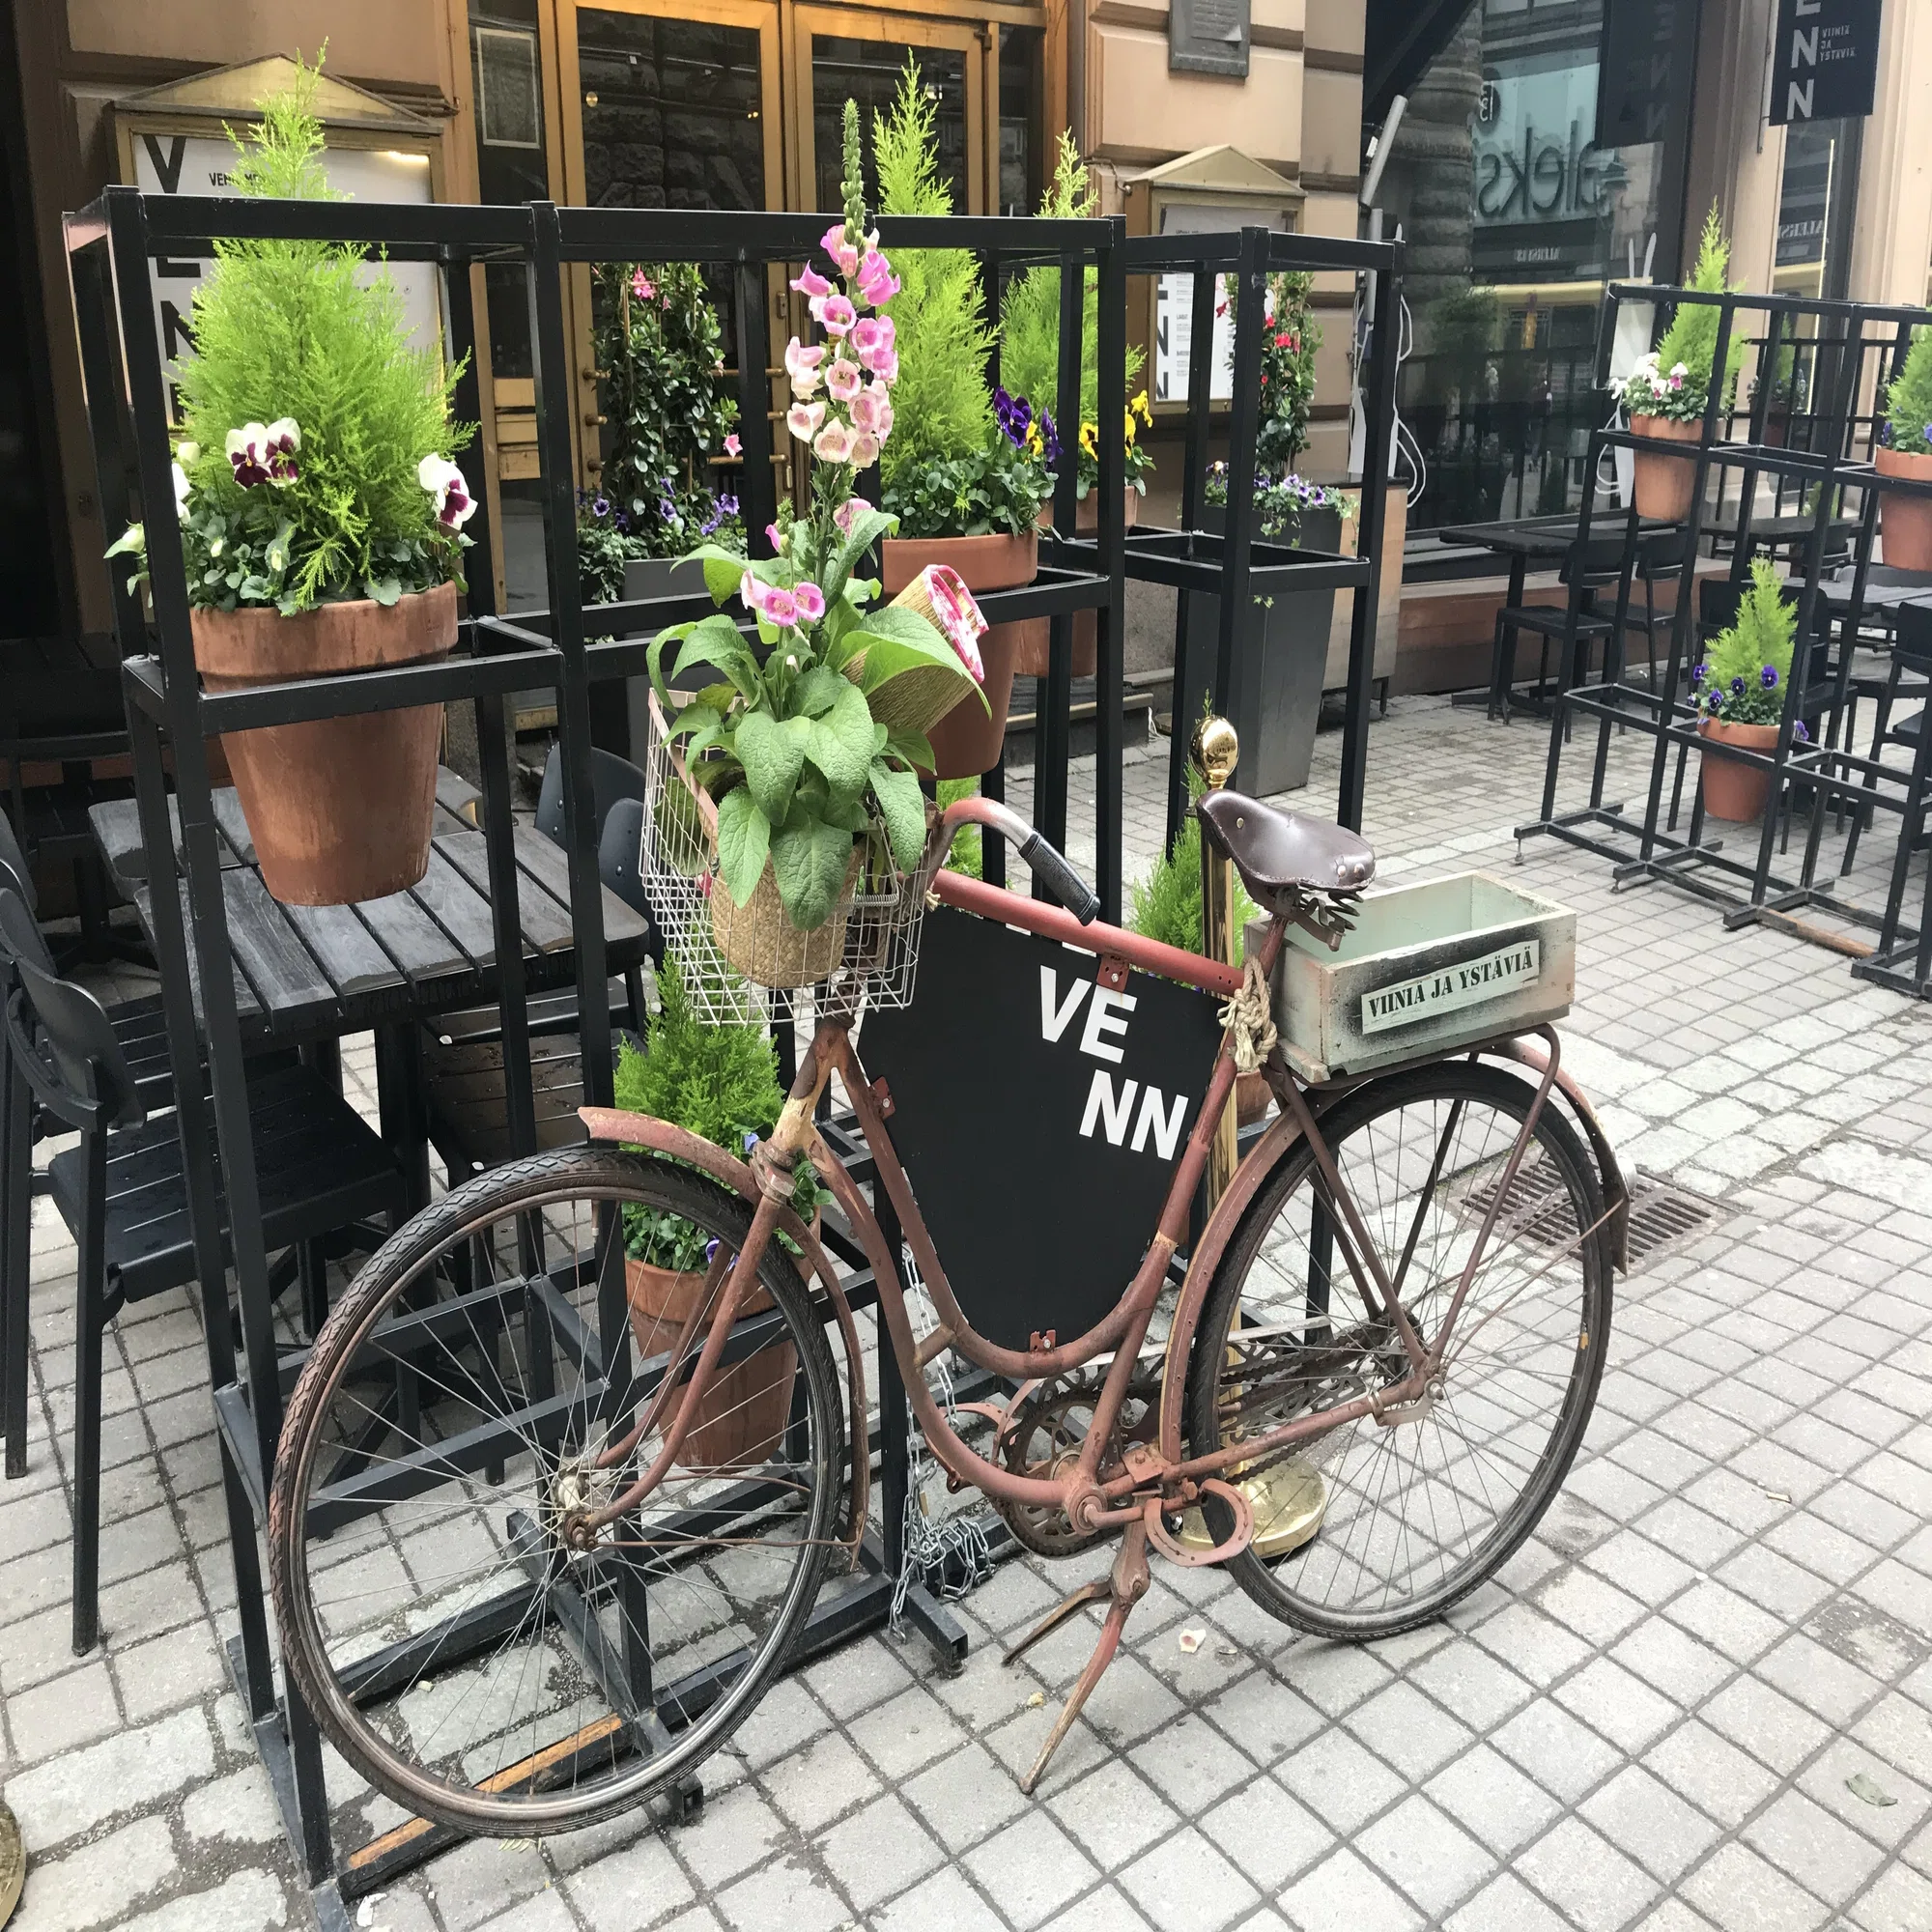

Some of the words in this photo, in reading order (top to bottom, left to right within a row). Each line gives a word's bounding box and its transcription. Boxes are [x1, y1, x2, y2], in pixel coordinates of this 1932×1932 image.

[1820, 39, 1832, 50] JA
[1431, 976, 1454, 999] JA
[1459, 946, 1533, 989] YSTÄVIÄ
[1038, 965, 1138, 1064] VE
[1078, 1068, 1190, 1161] NN
